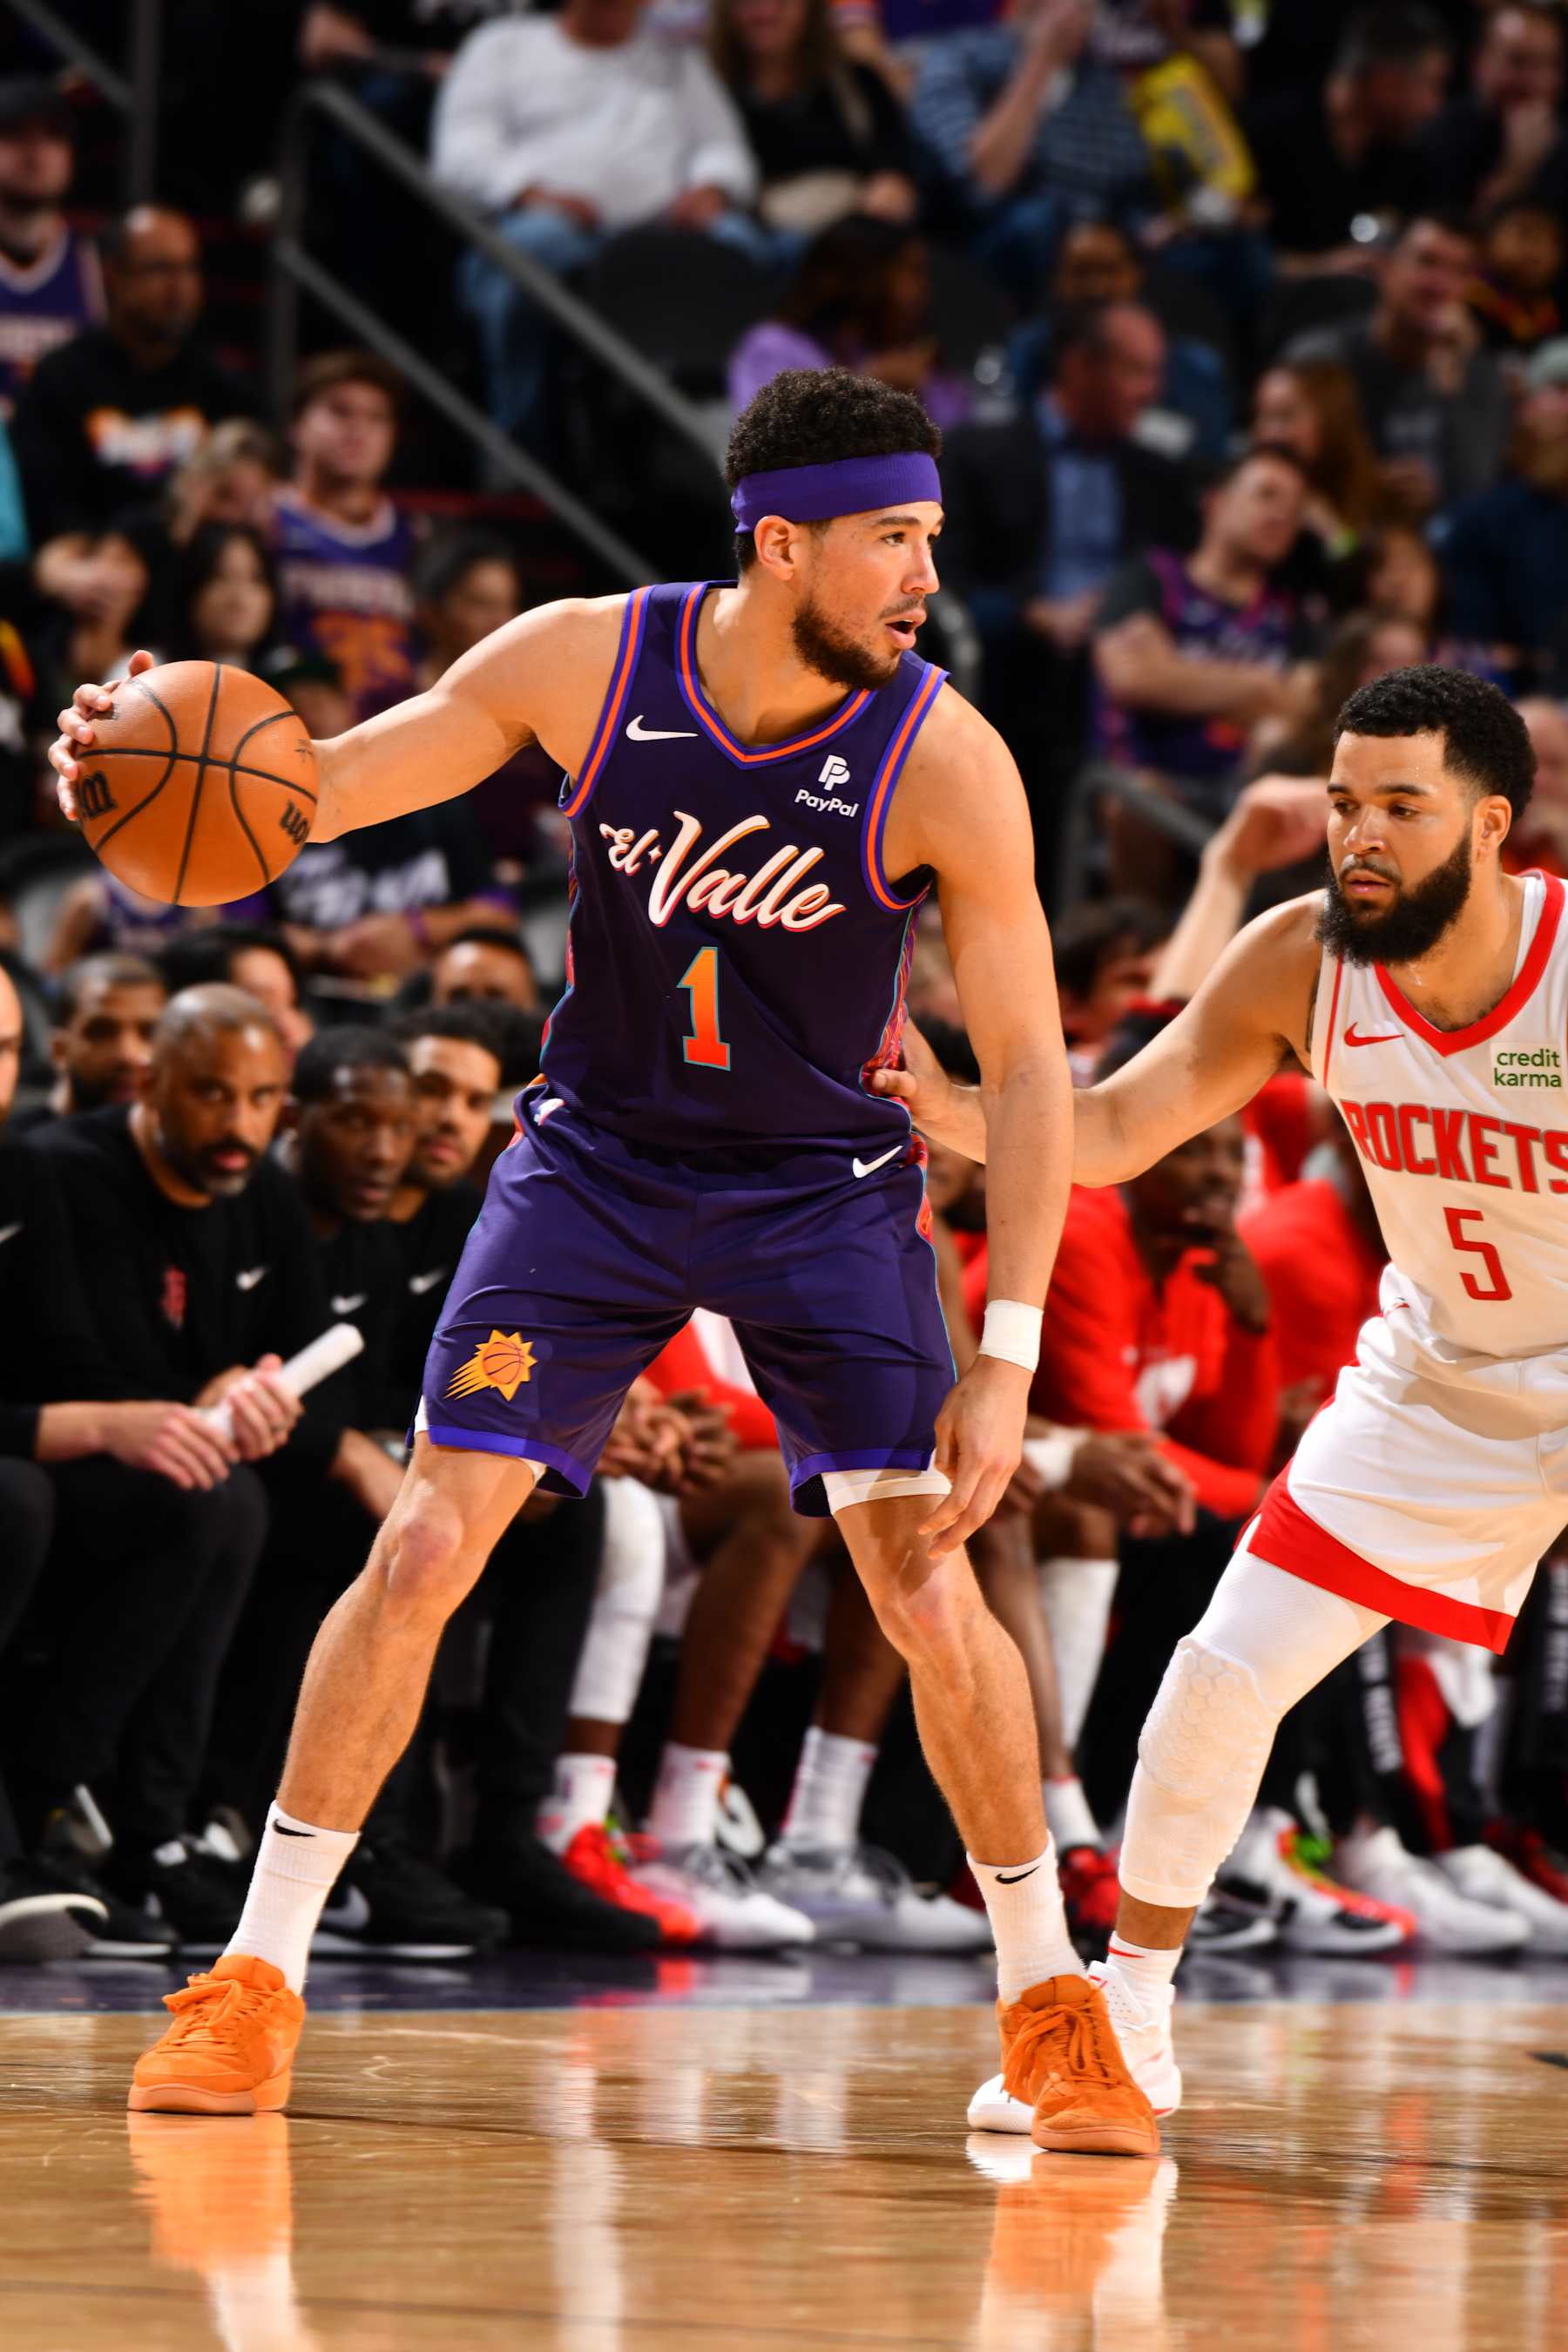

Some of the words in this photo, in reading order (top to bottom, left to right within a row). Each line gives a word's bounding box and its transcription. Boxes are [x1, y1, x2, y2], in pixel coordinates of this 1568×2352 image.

[794, 788, 859, 818] PayPal
[598, 822, 659, 876] El
[647, 810, 848, 933] Valle
[675, 946, 732, 1071] 1
[1493, 1067, 1563, 1089] karma
[1496, 1049, 1561, 1068] credit
[1339, 1098, 1568, 1194] ROCKETS
[1443, 1206, 1513, 1301] 5
